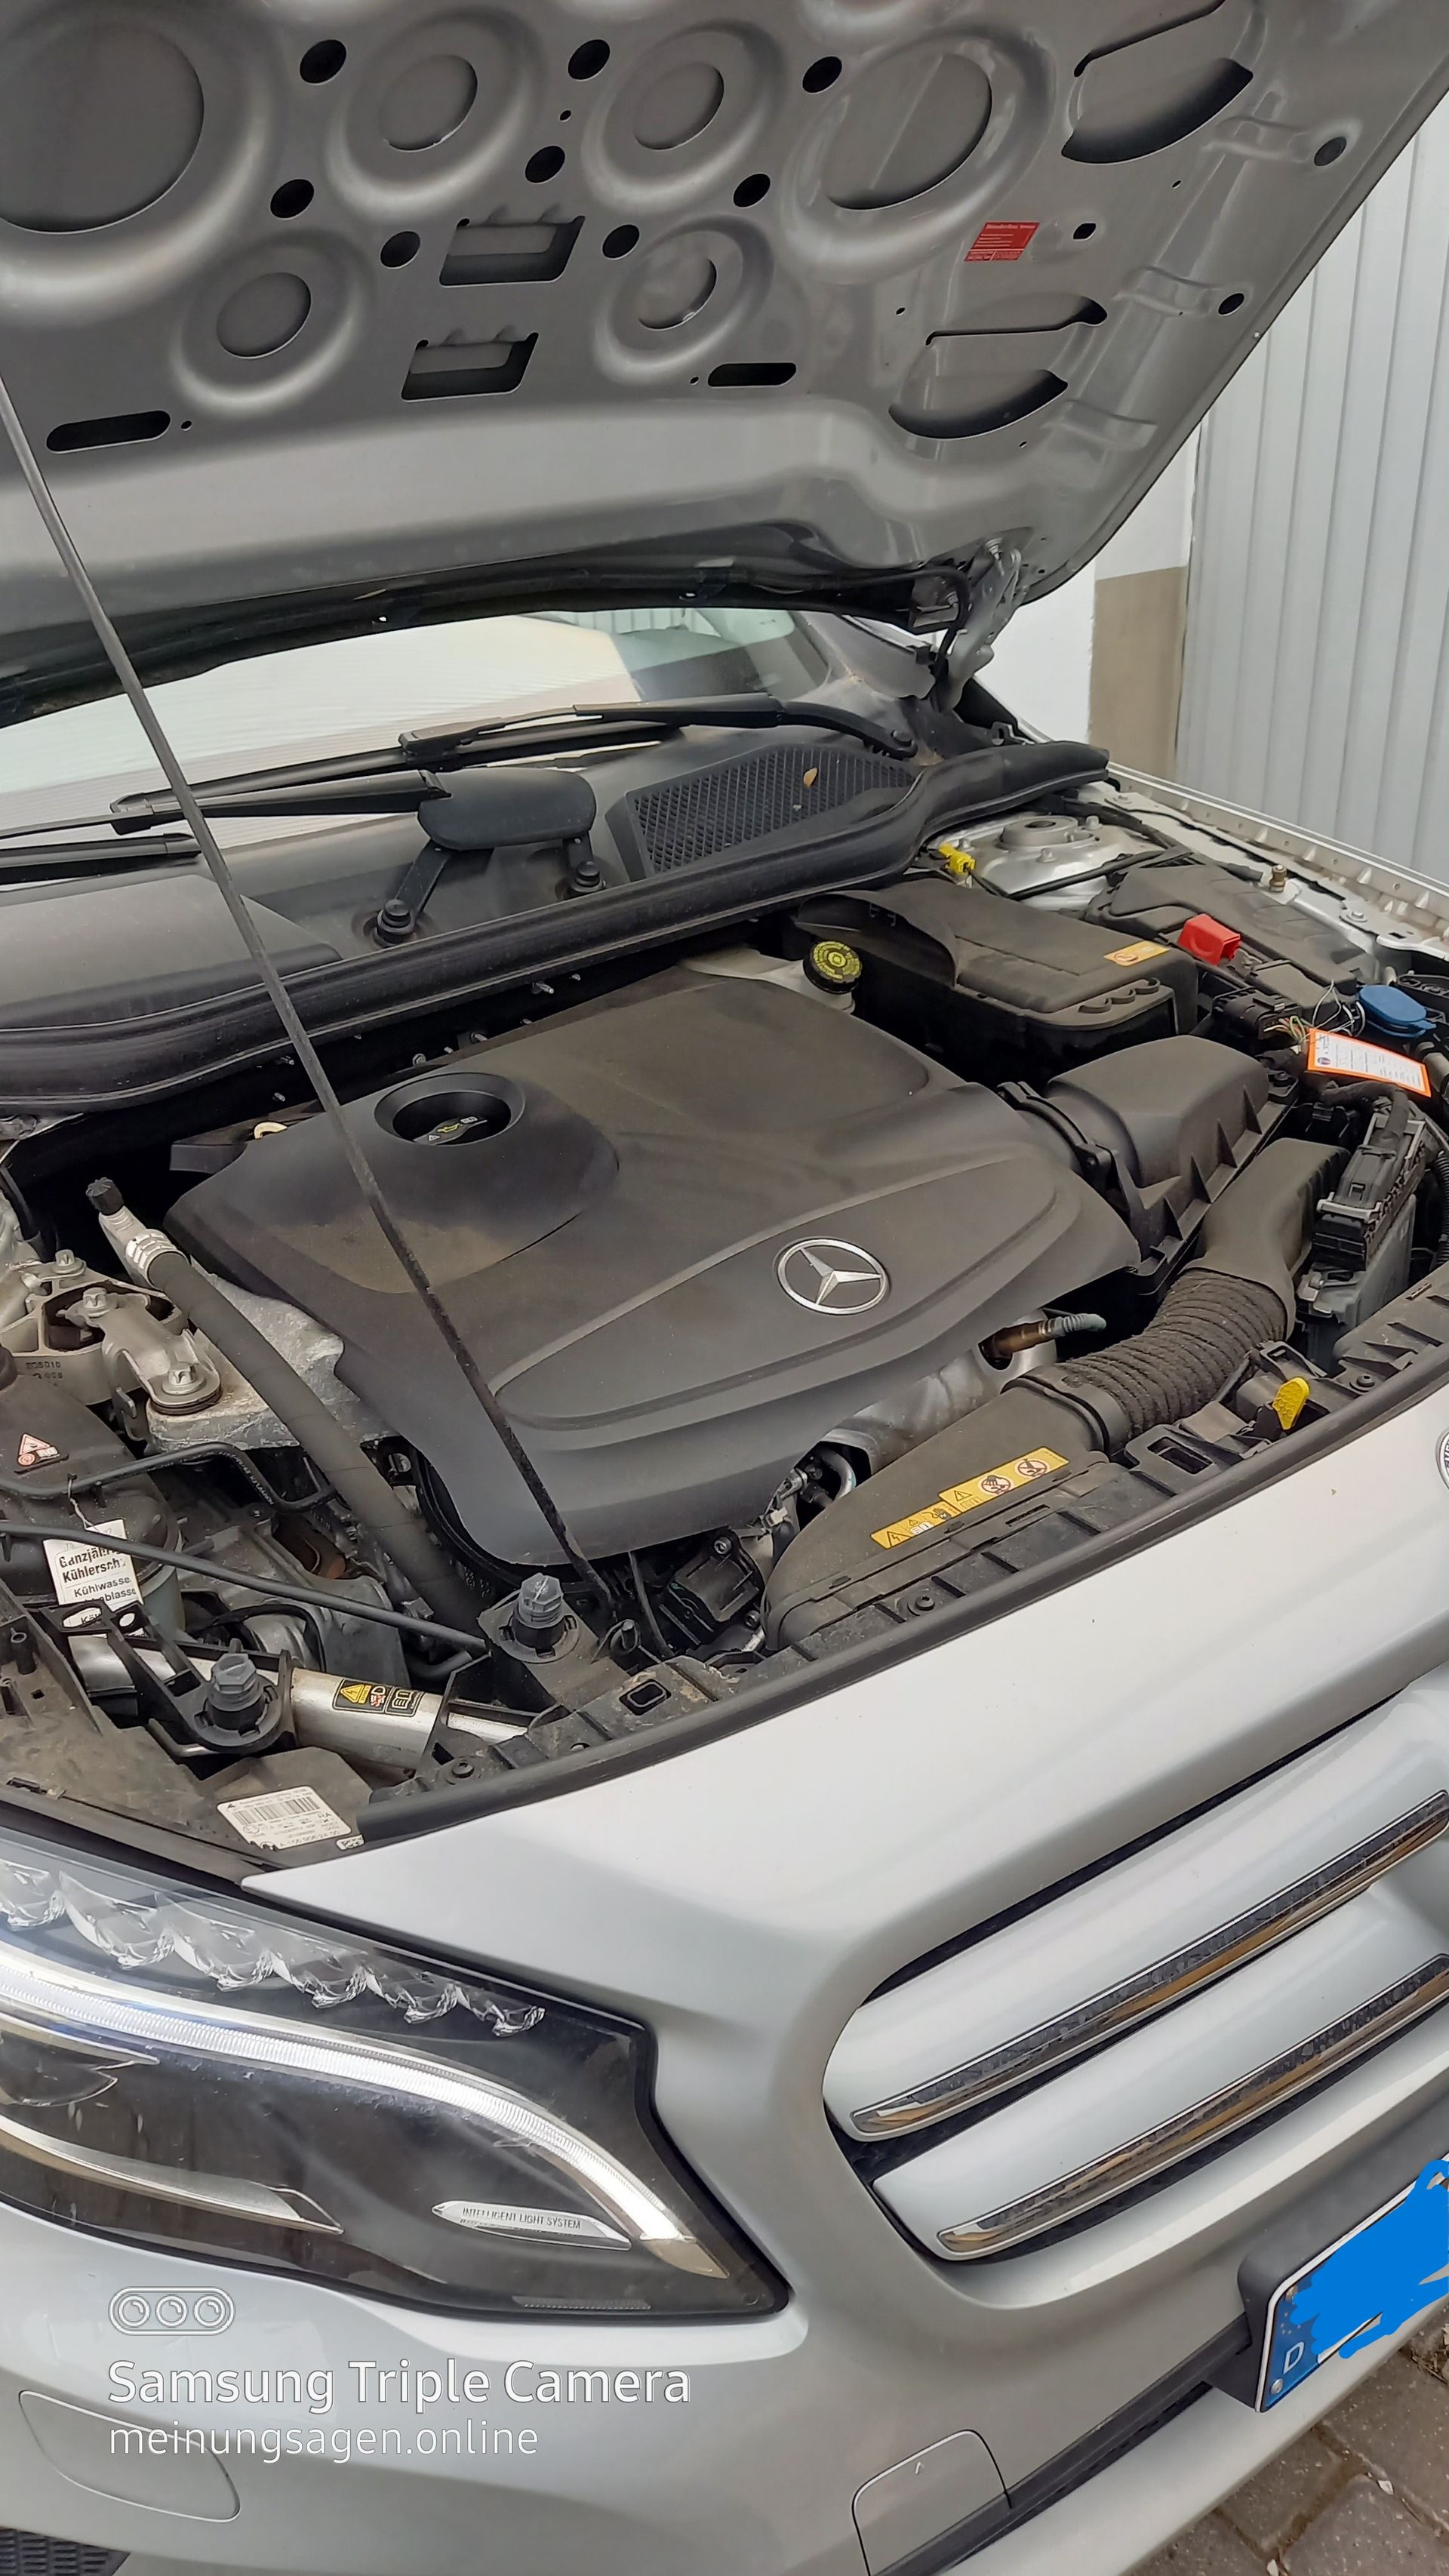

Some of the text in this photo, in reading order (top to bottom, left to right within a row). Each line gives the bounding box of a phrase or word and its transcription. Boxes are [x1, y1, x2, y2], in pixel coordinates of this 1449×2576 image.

[519, 2214, 544, 2225] LIGHT
[546, 2217, 581, 2230] SYSTEM
[1284, 2341, 1304, 2374] D
